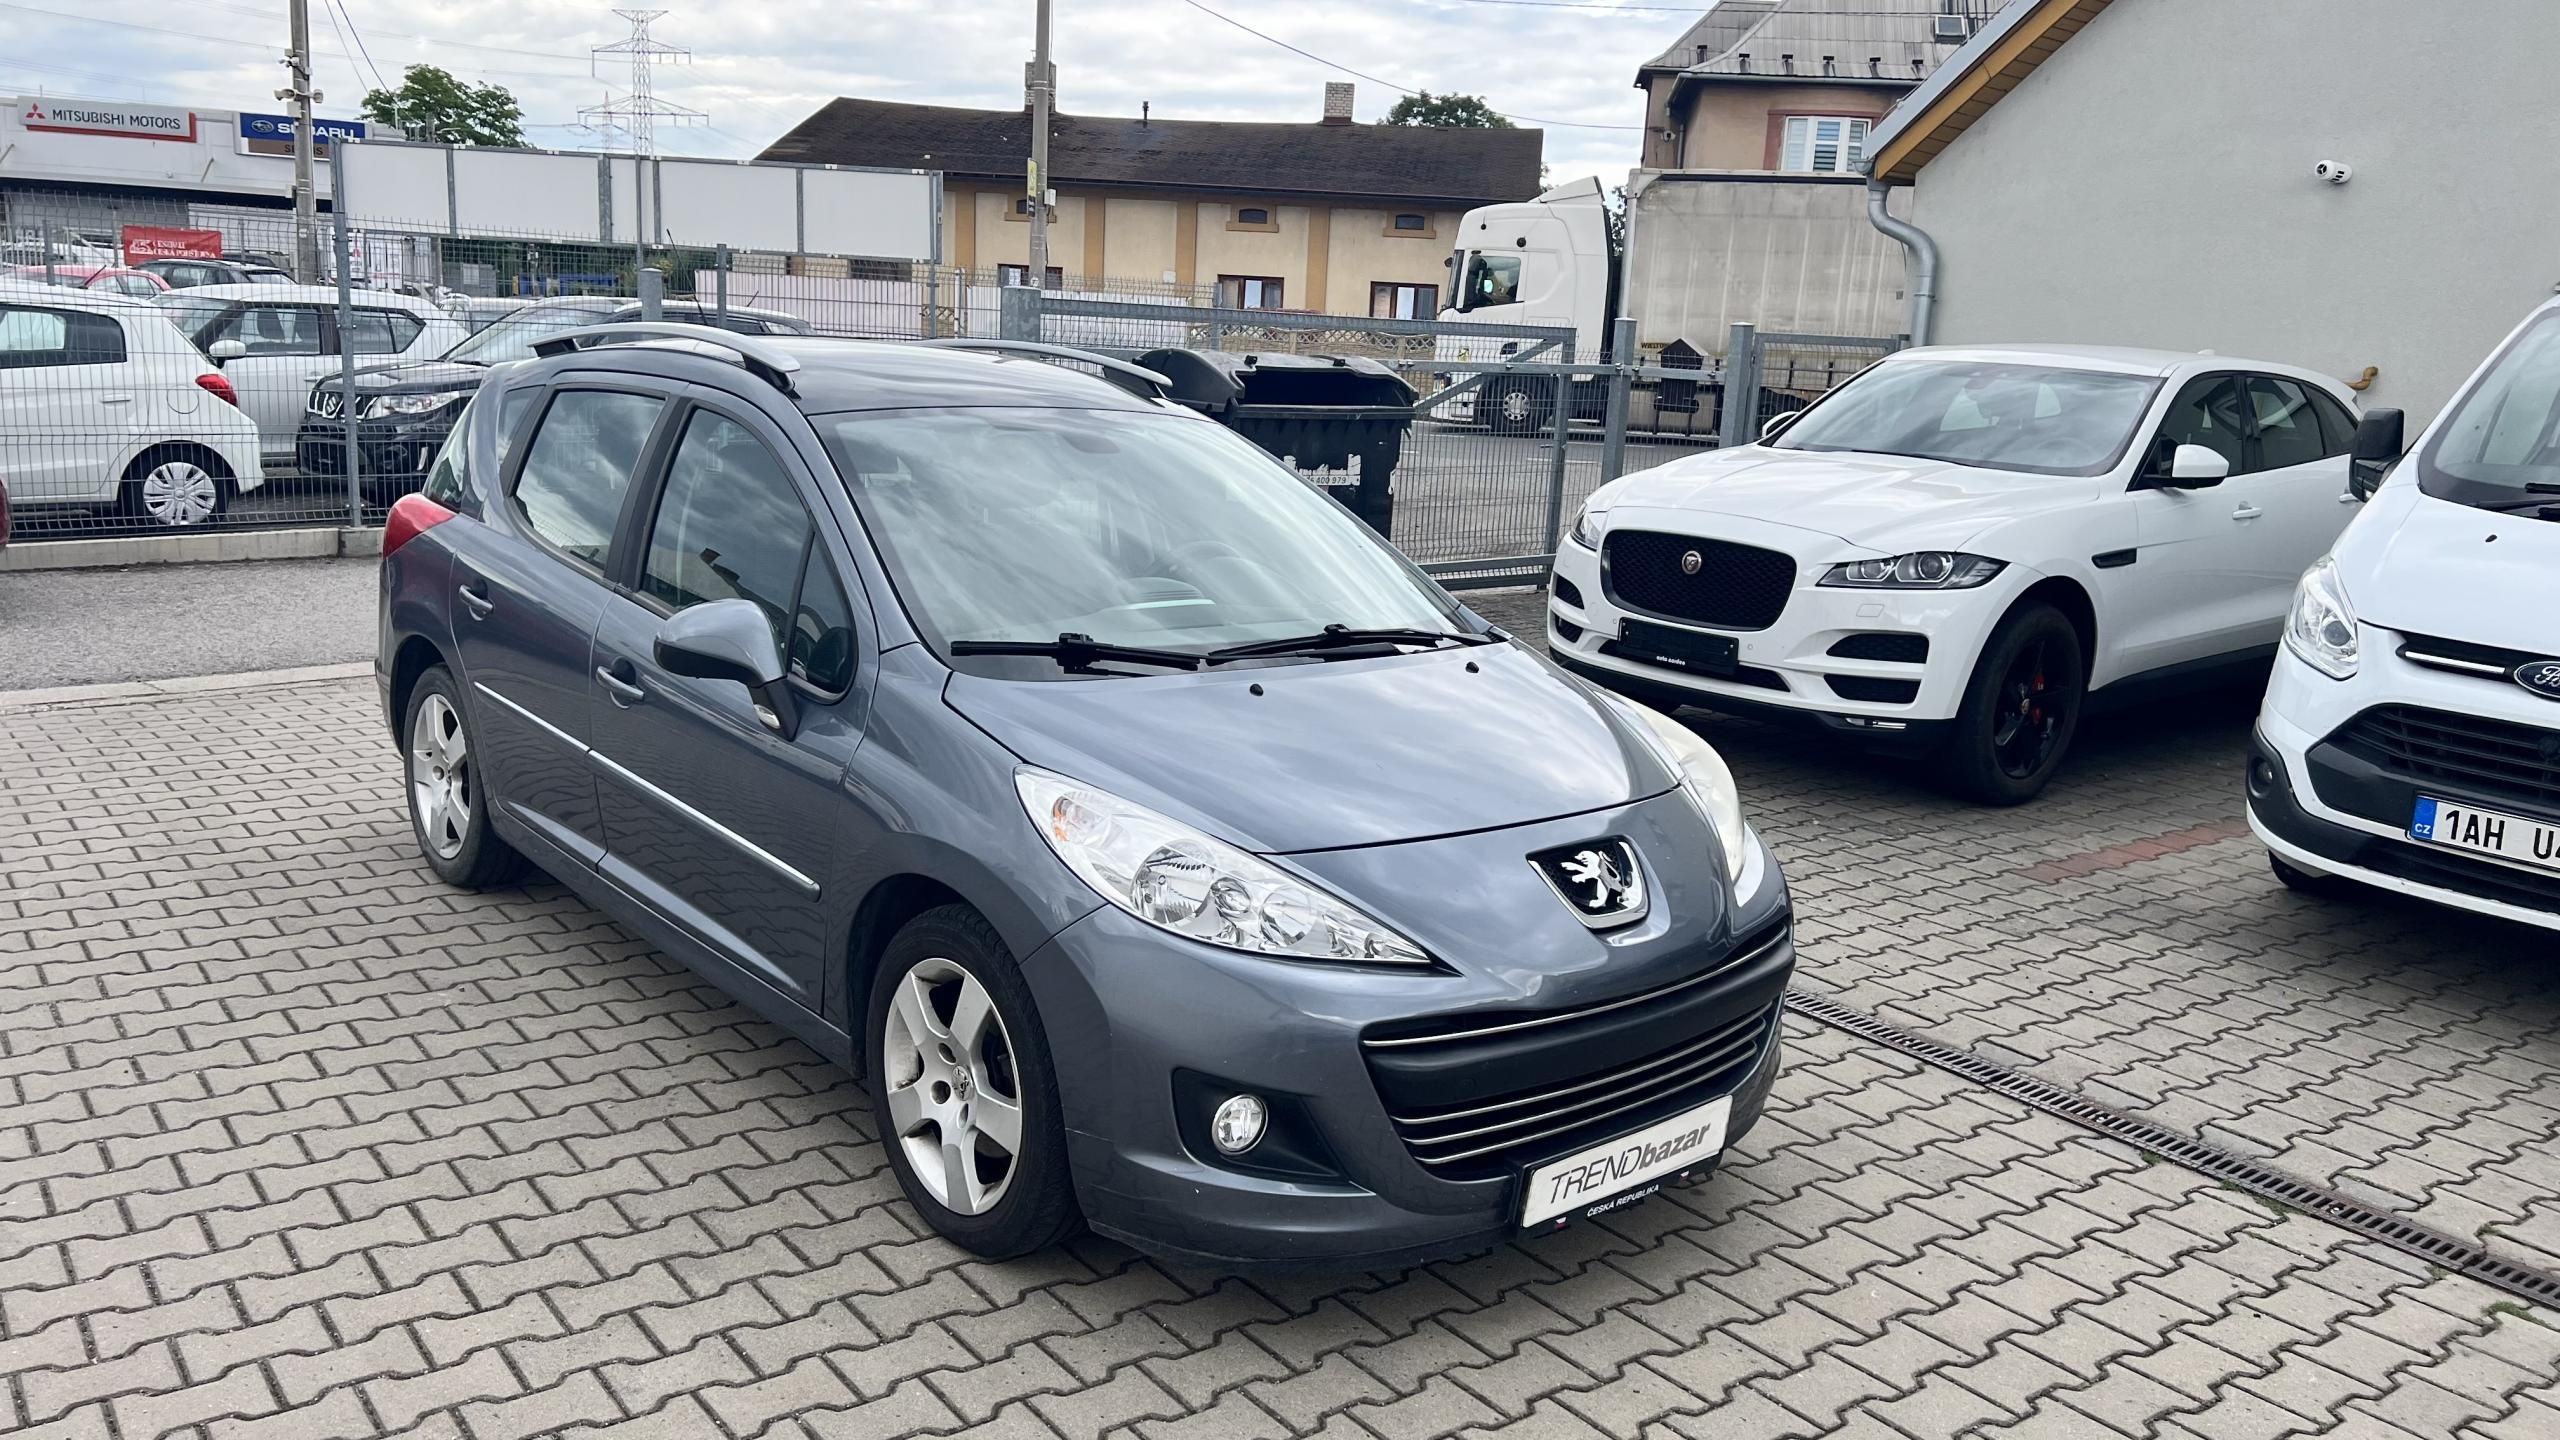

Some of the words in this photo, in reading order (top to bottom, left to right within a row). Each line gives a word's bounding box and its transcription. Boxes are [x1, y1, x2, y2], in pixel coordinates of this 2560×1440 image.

[52, 109, 125, 125] MITSUBISHI
[129, 114, 181, 130] MOTORS
[2414, 823, 2432, 835] CZ
[2446, 810, 2505, 850] 1AH
[1615, 1184, 1660, 1207] REPUBLIKA
